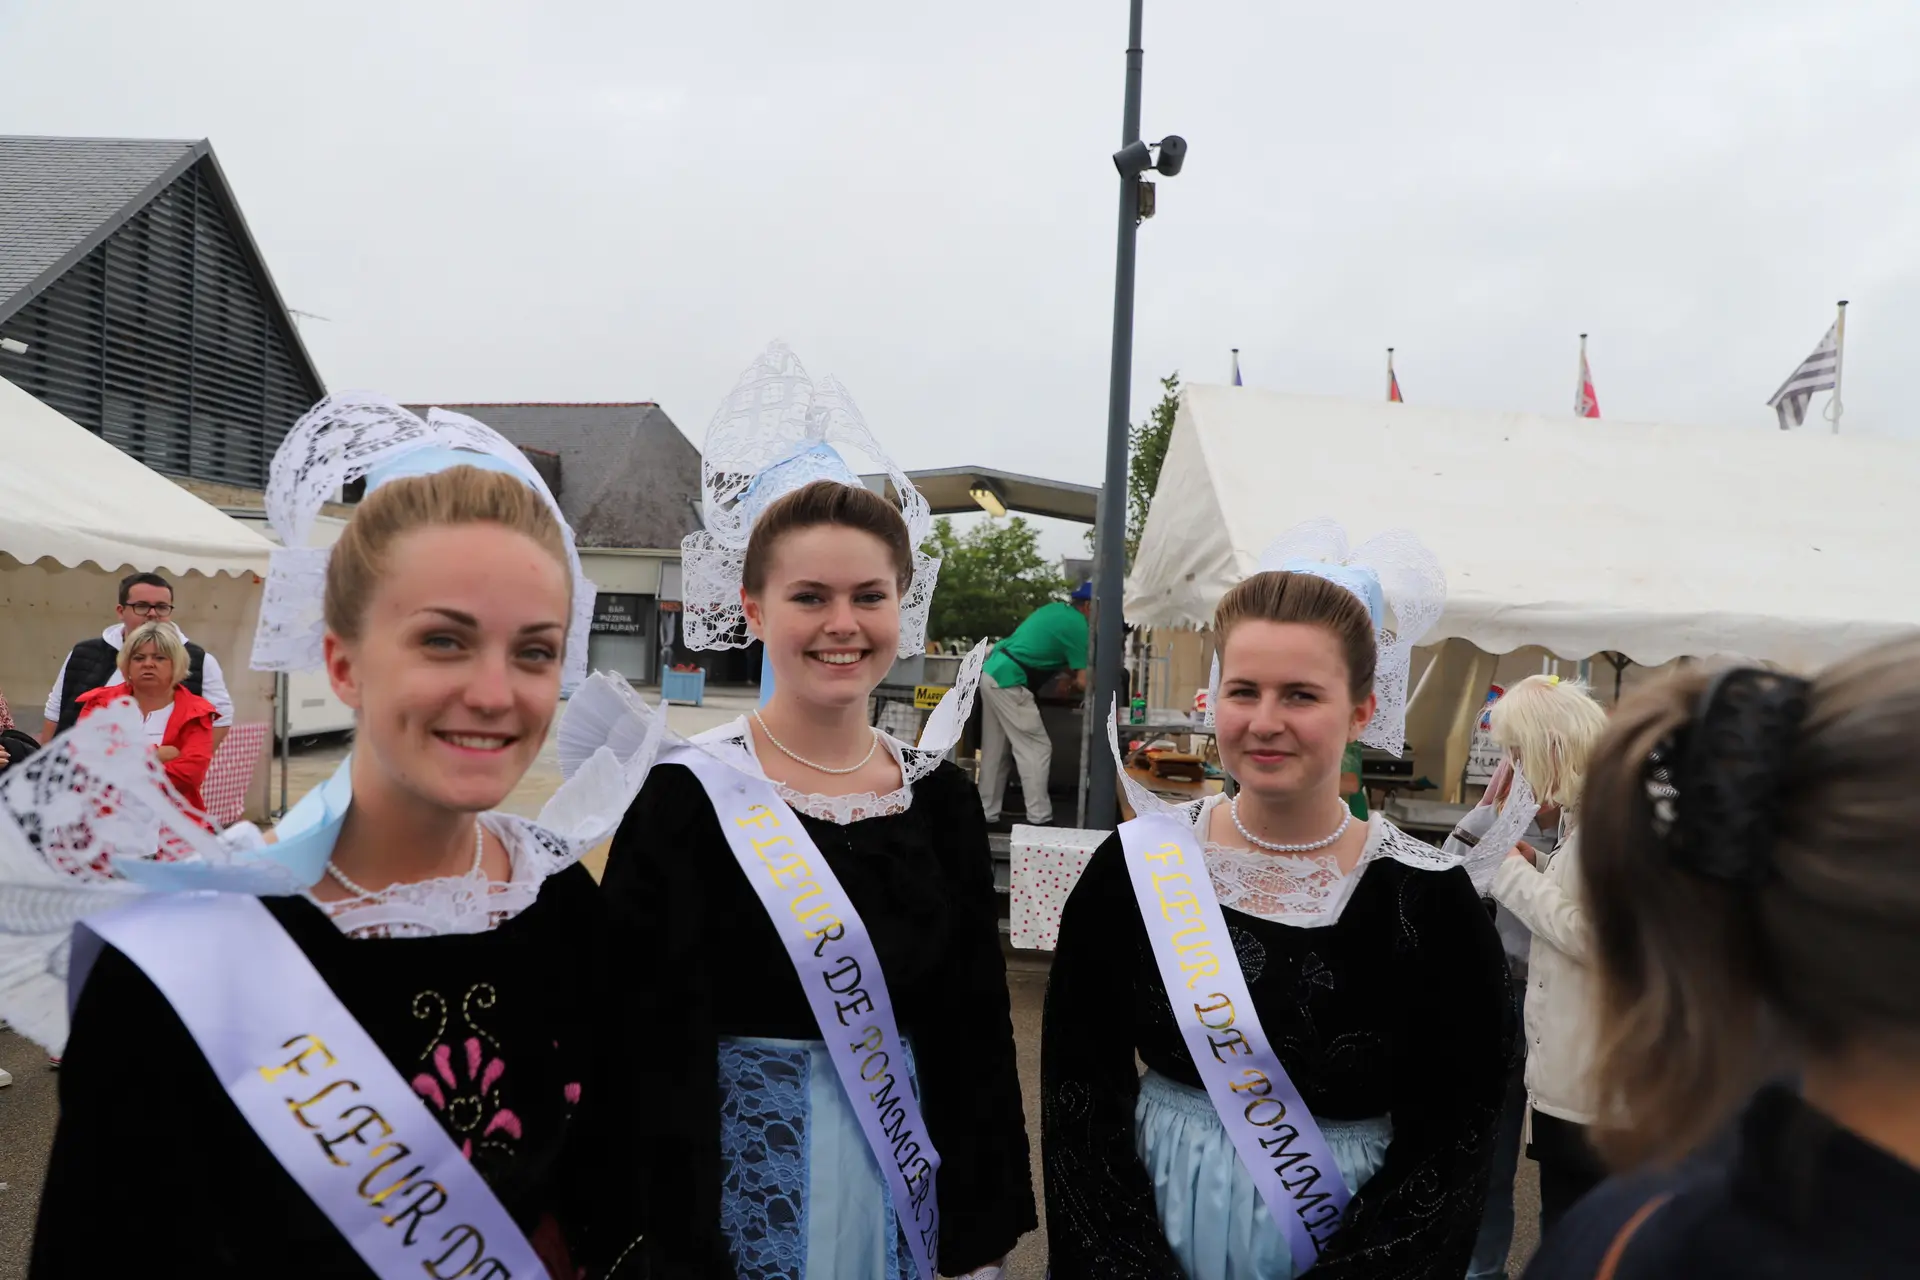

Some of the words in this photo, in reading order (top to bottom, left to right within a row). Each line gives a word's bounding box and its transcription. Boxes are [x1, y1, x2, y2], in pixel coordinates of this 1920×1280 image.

[591, 623, 640, 632] RESTAURANT
[599, 614, 632, 622] PIZZERIA
[608, 605, 625, 613] BAR
[1144, 842, 1220, 990] FLEUR
[1194, 992, 1254, 1064] DE
[735, 804, 845, 957] FLEUR
[823, 956, 874, 1026] DE
[850, 1025, 932, 1221] POMMIER
[258, 1034, 448, 1247] FLEUR
